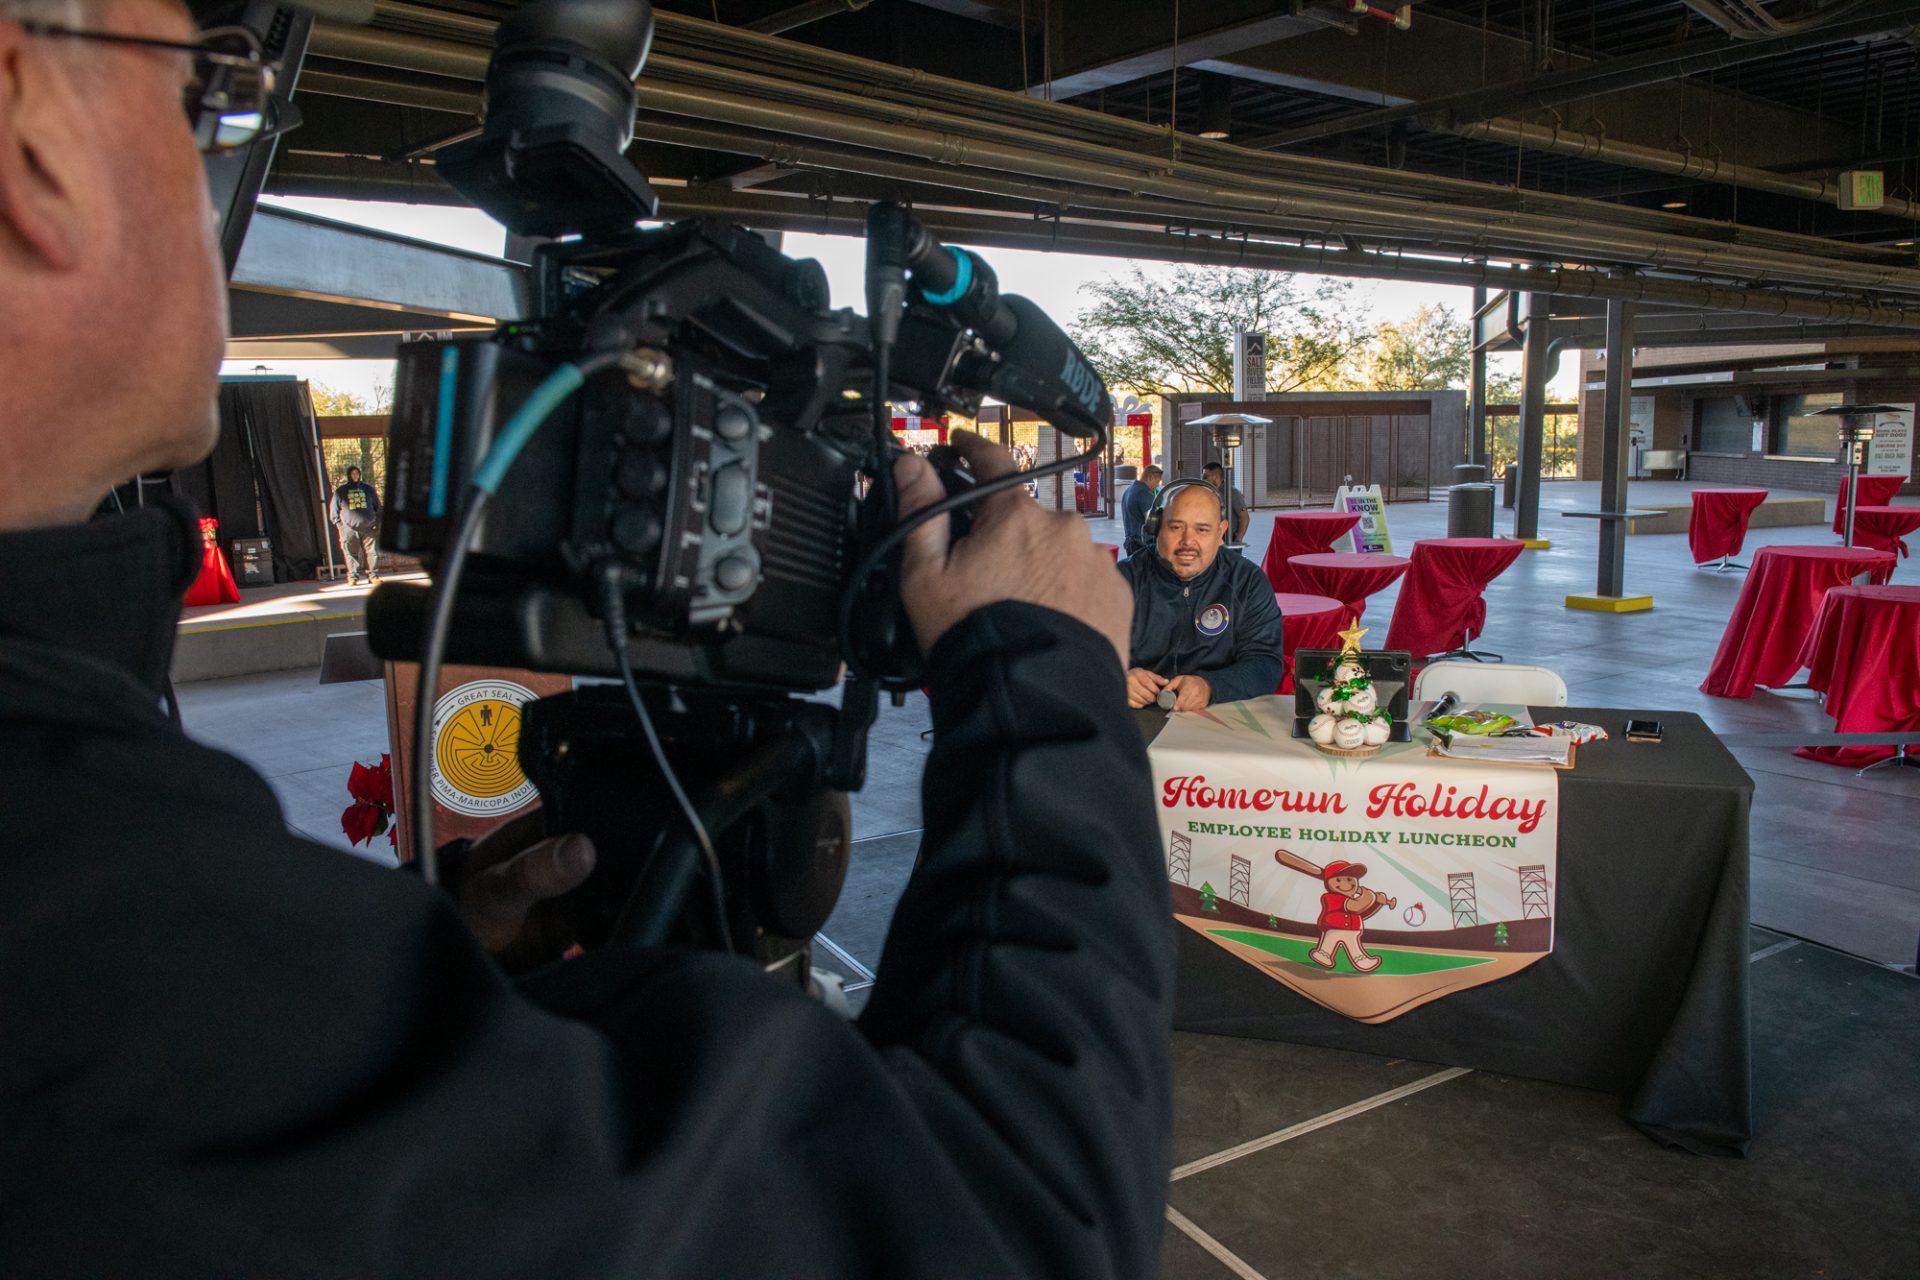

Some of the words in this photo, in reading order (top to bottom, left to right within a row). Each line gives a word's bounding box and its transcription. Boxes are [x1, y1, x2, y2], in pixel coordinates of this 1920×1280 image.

[1858, 175, 1882, 205] EXIT
[1247, 356, 1263, 368] SALT
[1351, 504, 1378, 512] KNOW
[457, 689, 488, 706] GREAT
[491, 689, 513, 701] SEAL
[436, 778, 510, 808] PIMA-MARICOPA
[1162, 775, 1348, 814] Homerun
[1366, 782, 1547, 834] Holiday
[1187, 821, 1292, 839] EMPLOYEE
[1298, 828, 1391, 843] HOLIDAY
[1398, 832, 1517, 848] LUNCHEON
